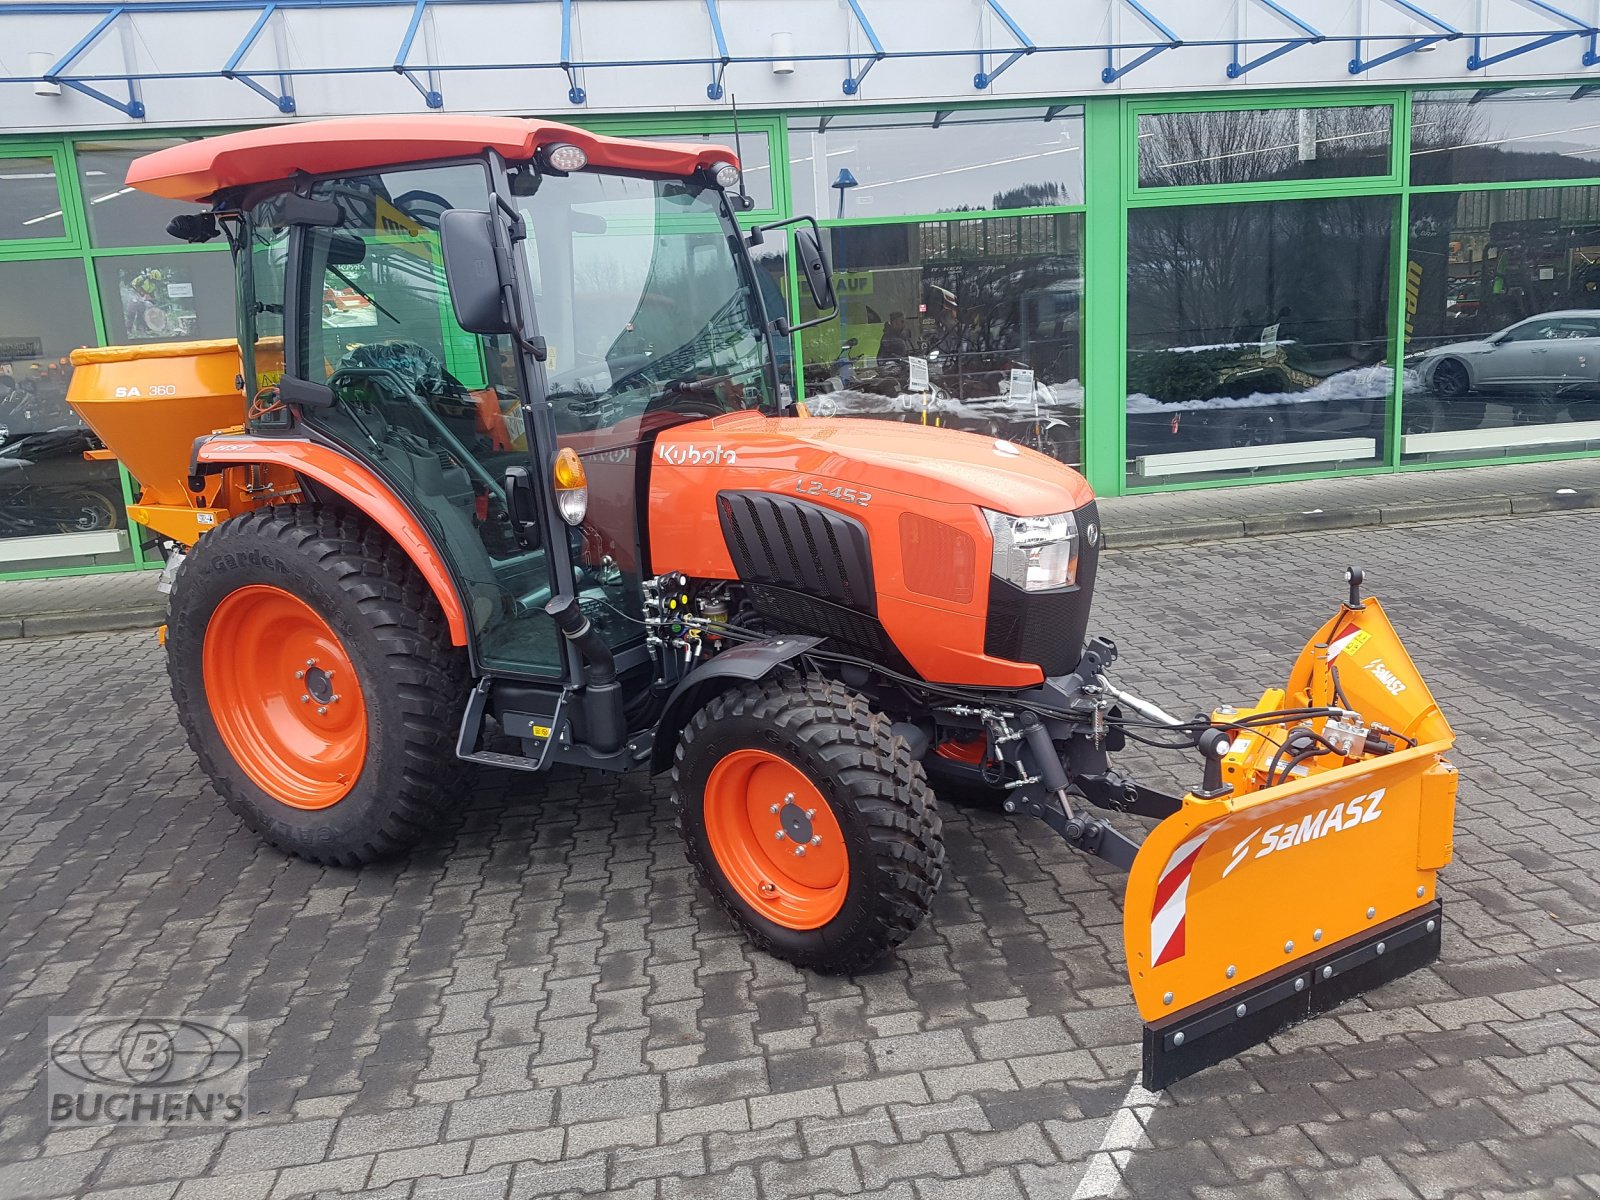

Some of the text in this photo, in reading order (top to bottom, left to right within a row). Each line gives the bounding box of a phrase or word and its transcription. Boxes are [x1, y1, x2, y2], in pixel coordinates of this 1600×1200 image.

[115, 384, 176, 398] SA 360
[659, 444, 736, 465] Kubota
[796, 479, 873, 508] L2-452
[1371, 663, 1406, 696] SaMASZ
[1254, 788, 1387, 860] SaMASZ
